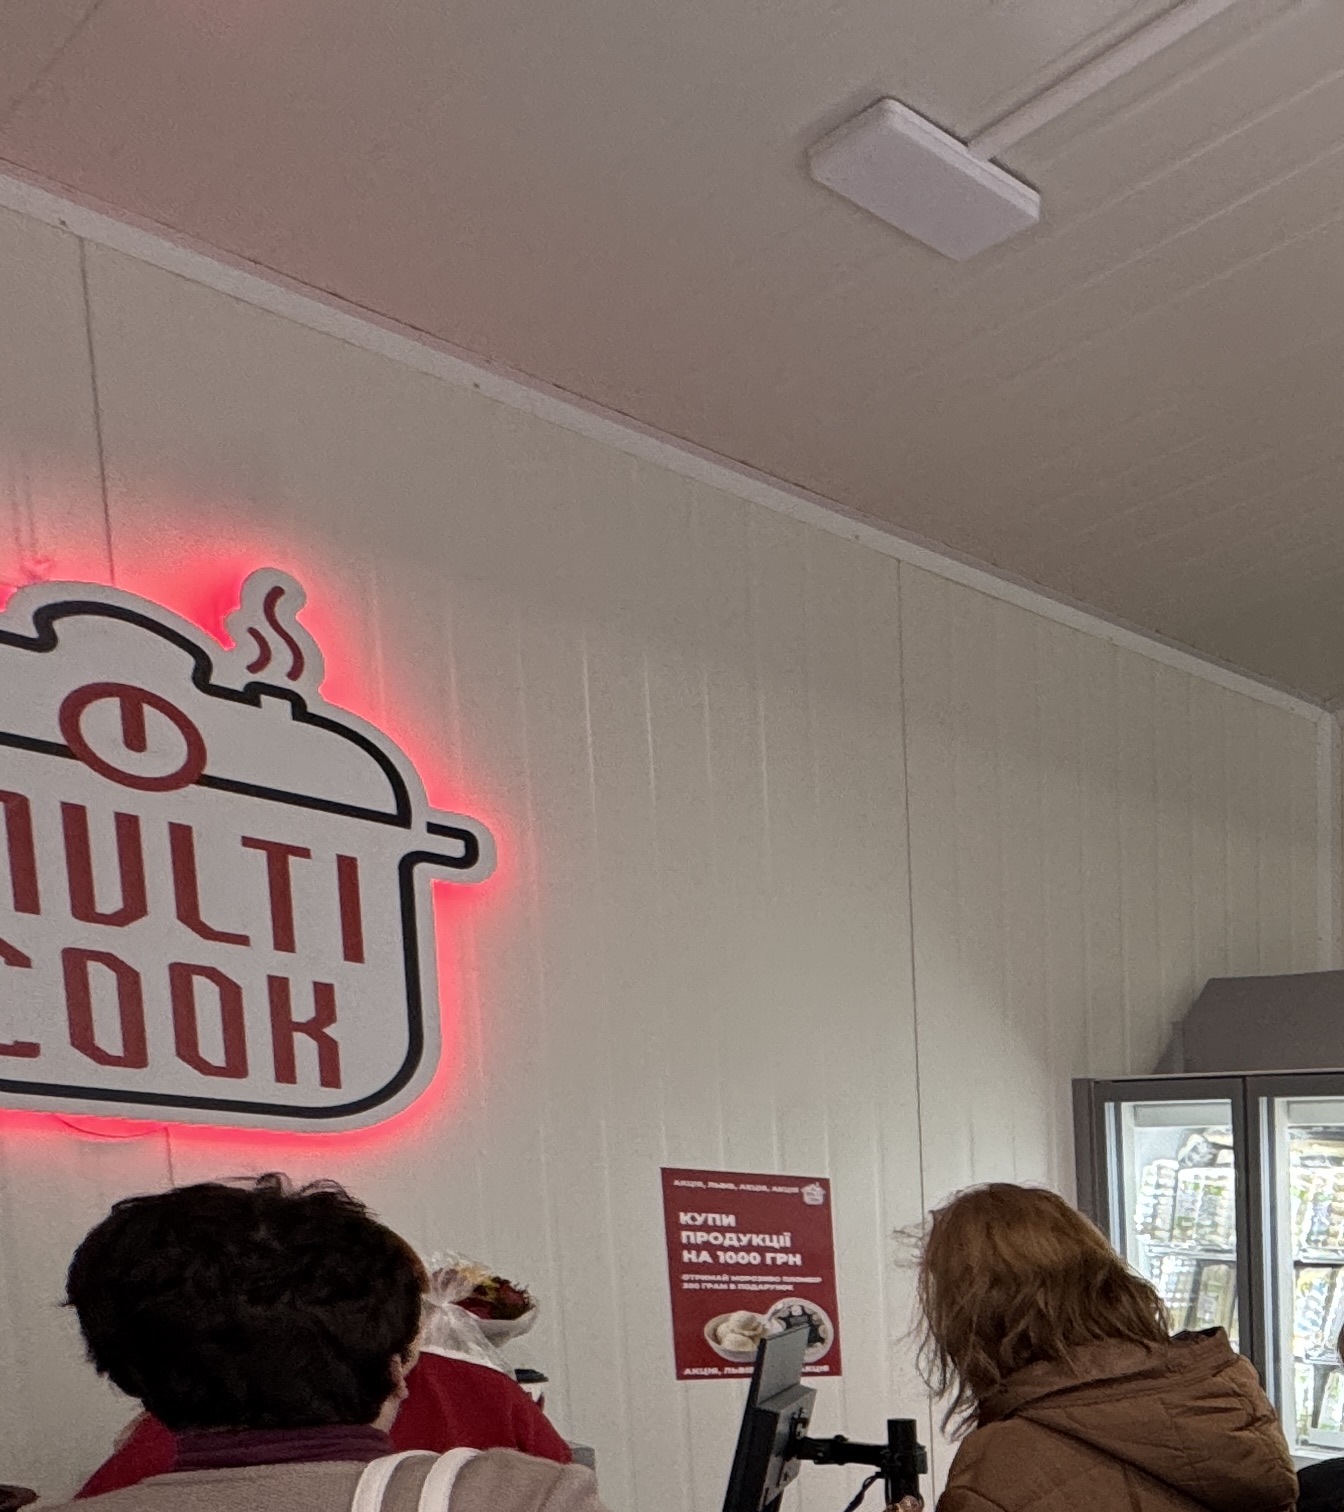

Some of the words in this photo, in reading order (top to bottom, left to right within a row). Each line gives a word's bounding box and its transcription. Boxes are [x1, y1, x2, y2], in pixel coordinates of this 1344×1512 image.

[679, 1211, 736, 1227] КУПИ
[680, 1231, 792, 1249] ПРОДУКЦІЇ
[682, 1250, 713, 1264] НА
[717, 1251, 761, 1265] 1000
[766, 1252, 802, 1266] ГРН
[701, 1282, 729, 1290] ГРАМ
[801, 1365, 830, 1373] КЦІЯ
